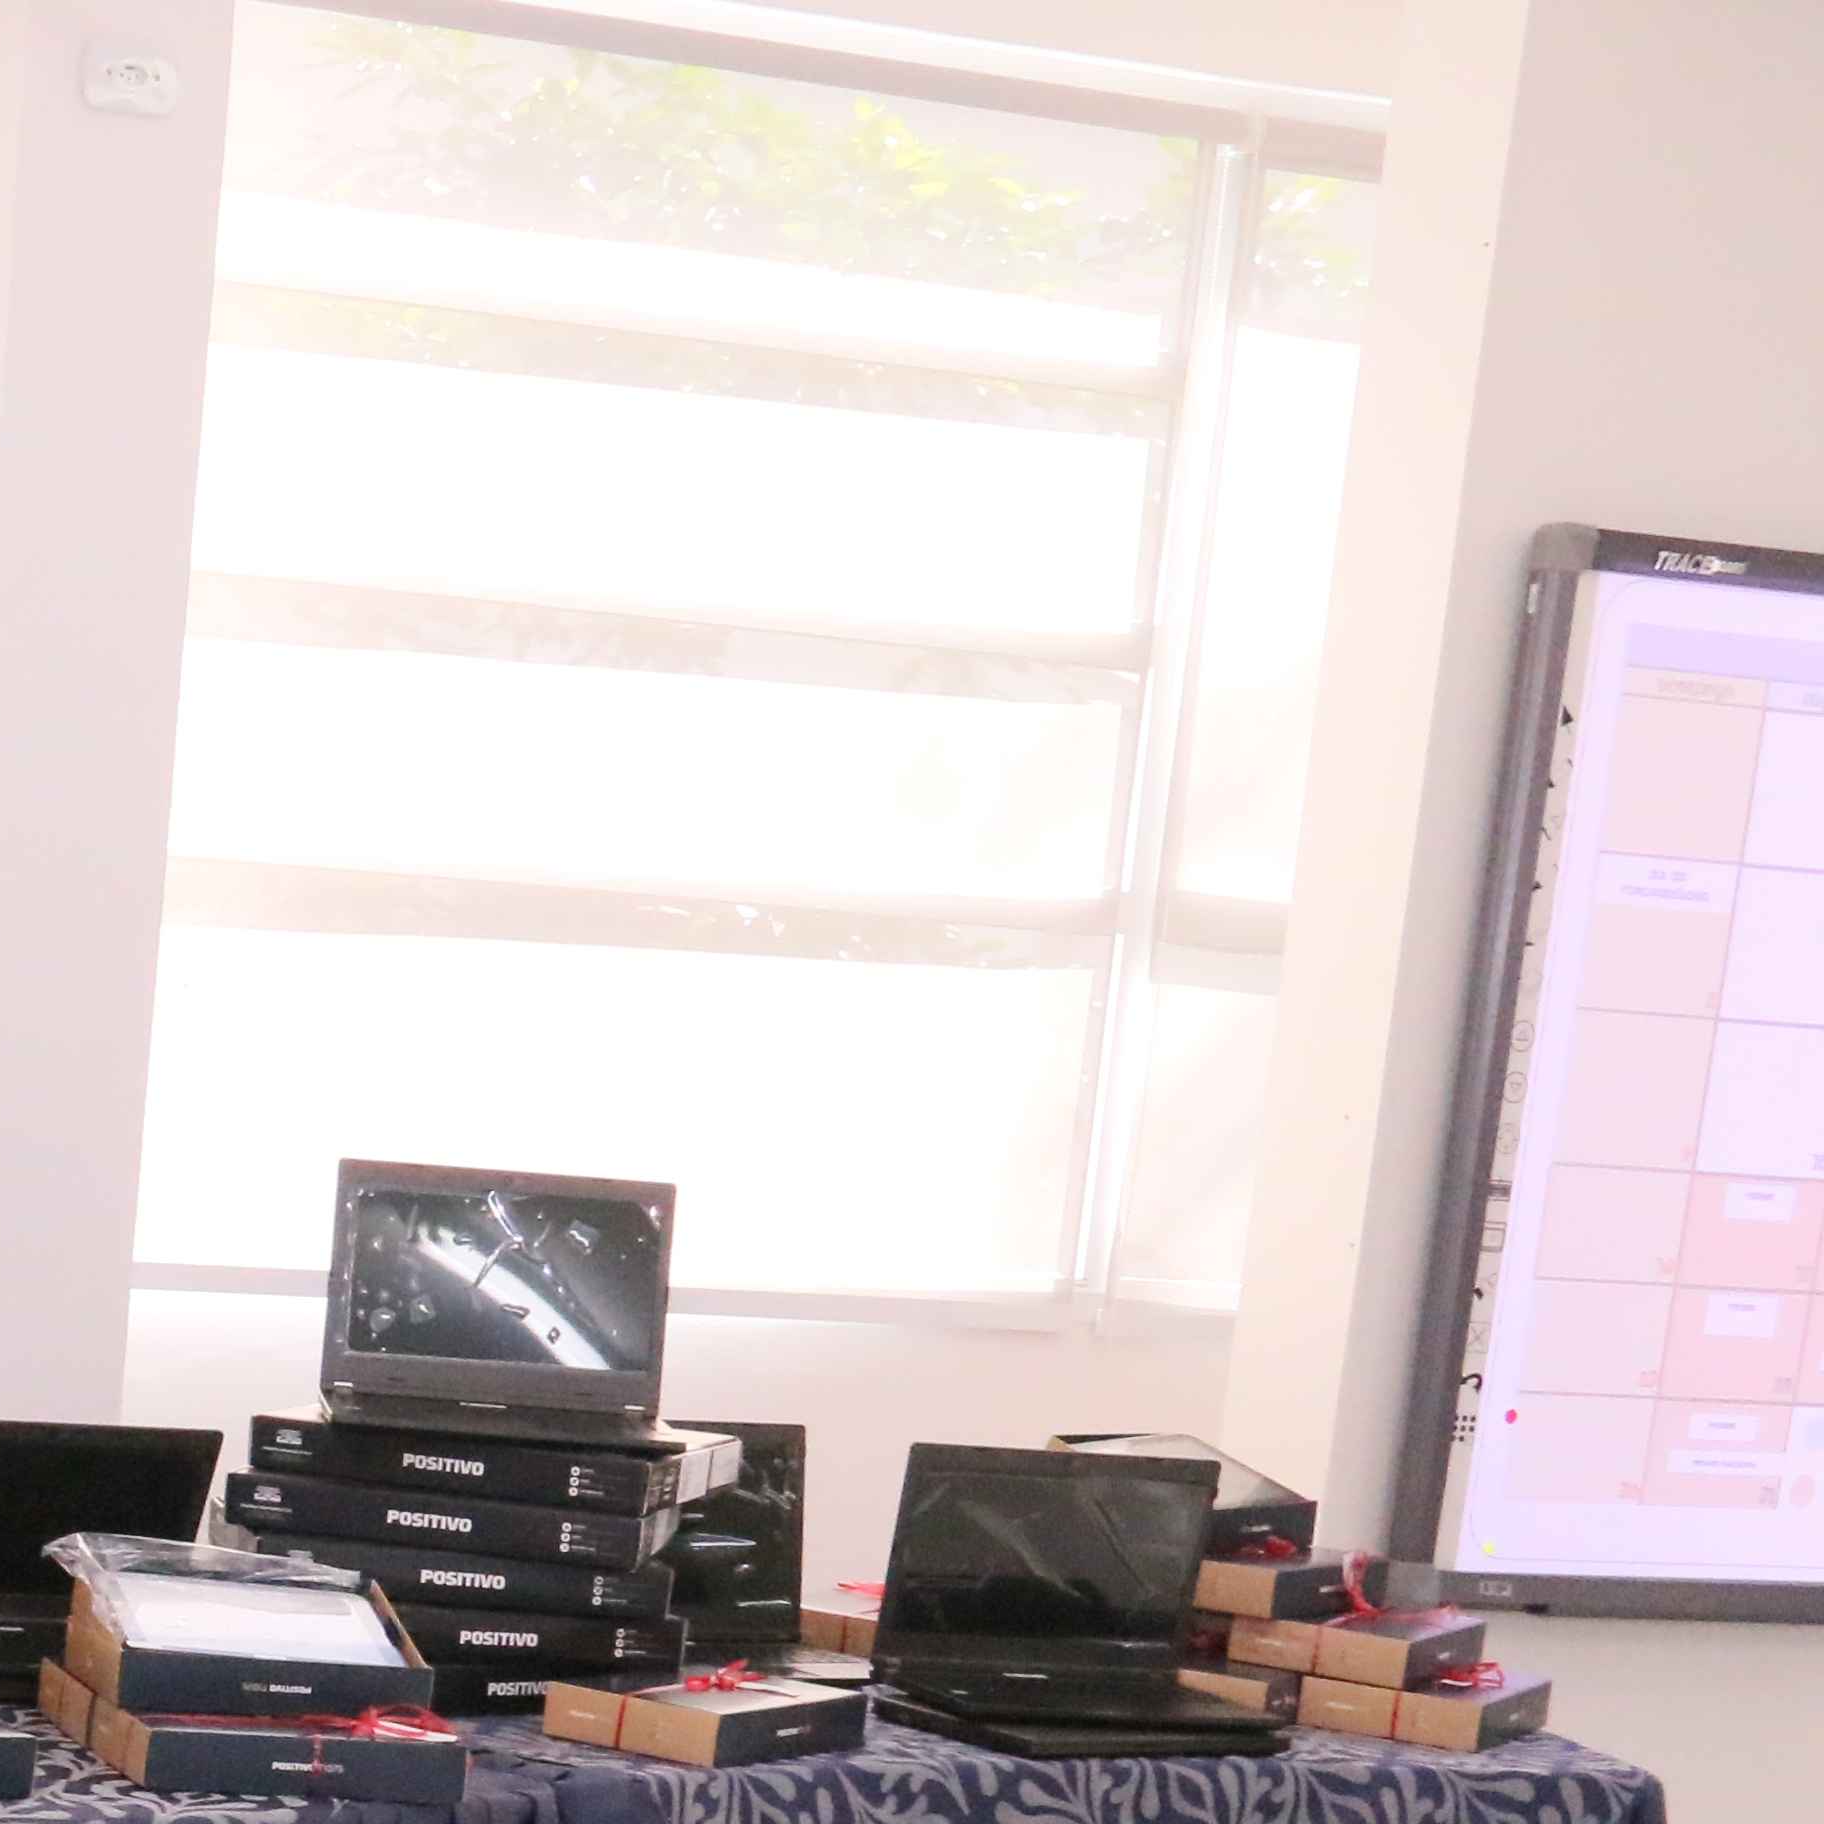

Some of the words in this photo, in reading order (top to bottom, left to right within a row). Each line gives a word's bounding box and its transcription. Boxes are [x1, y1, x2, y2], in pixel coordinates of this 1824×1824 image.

[403, 1453, 484, 1476] POSITIVO
[386, 1509, 473, 1533] POSITIVO
[420, 1569, 506, 1590] POSITIVO
[459, 1631, 539, 1647] POSITIVO
